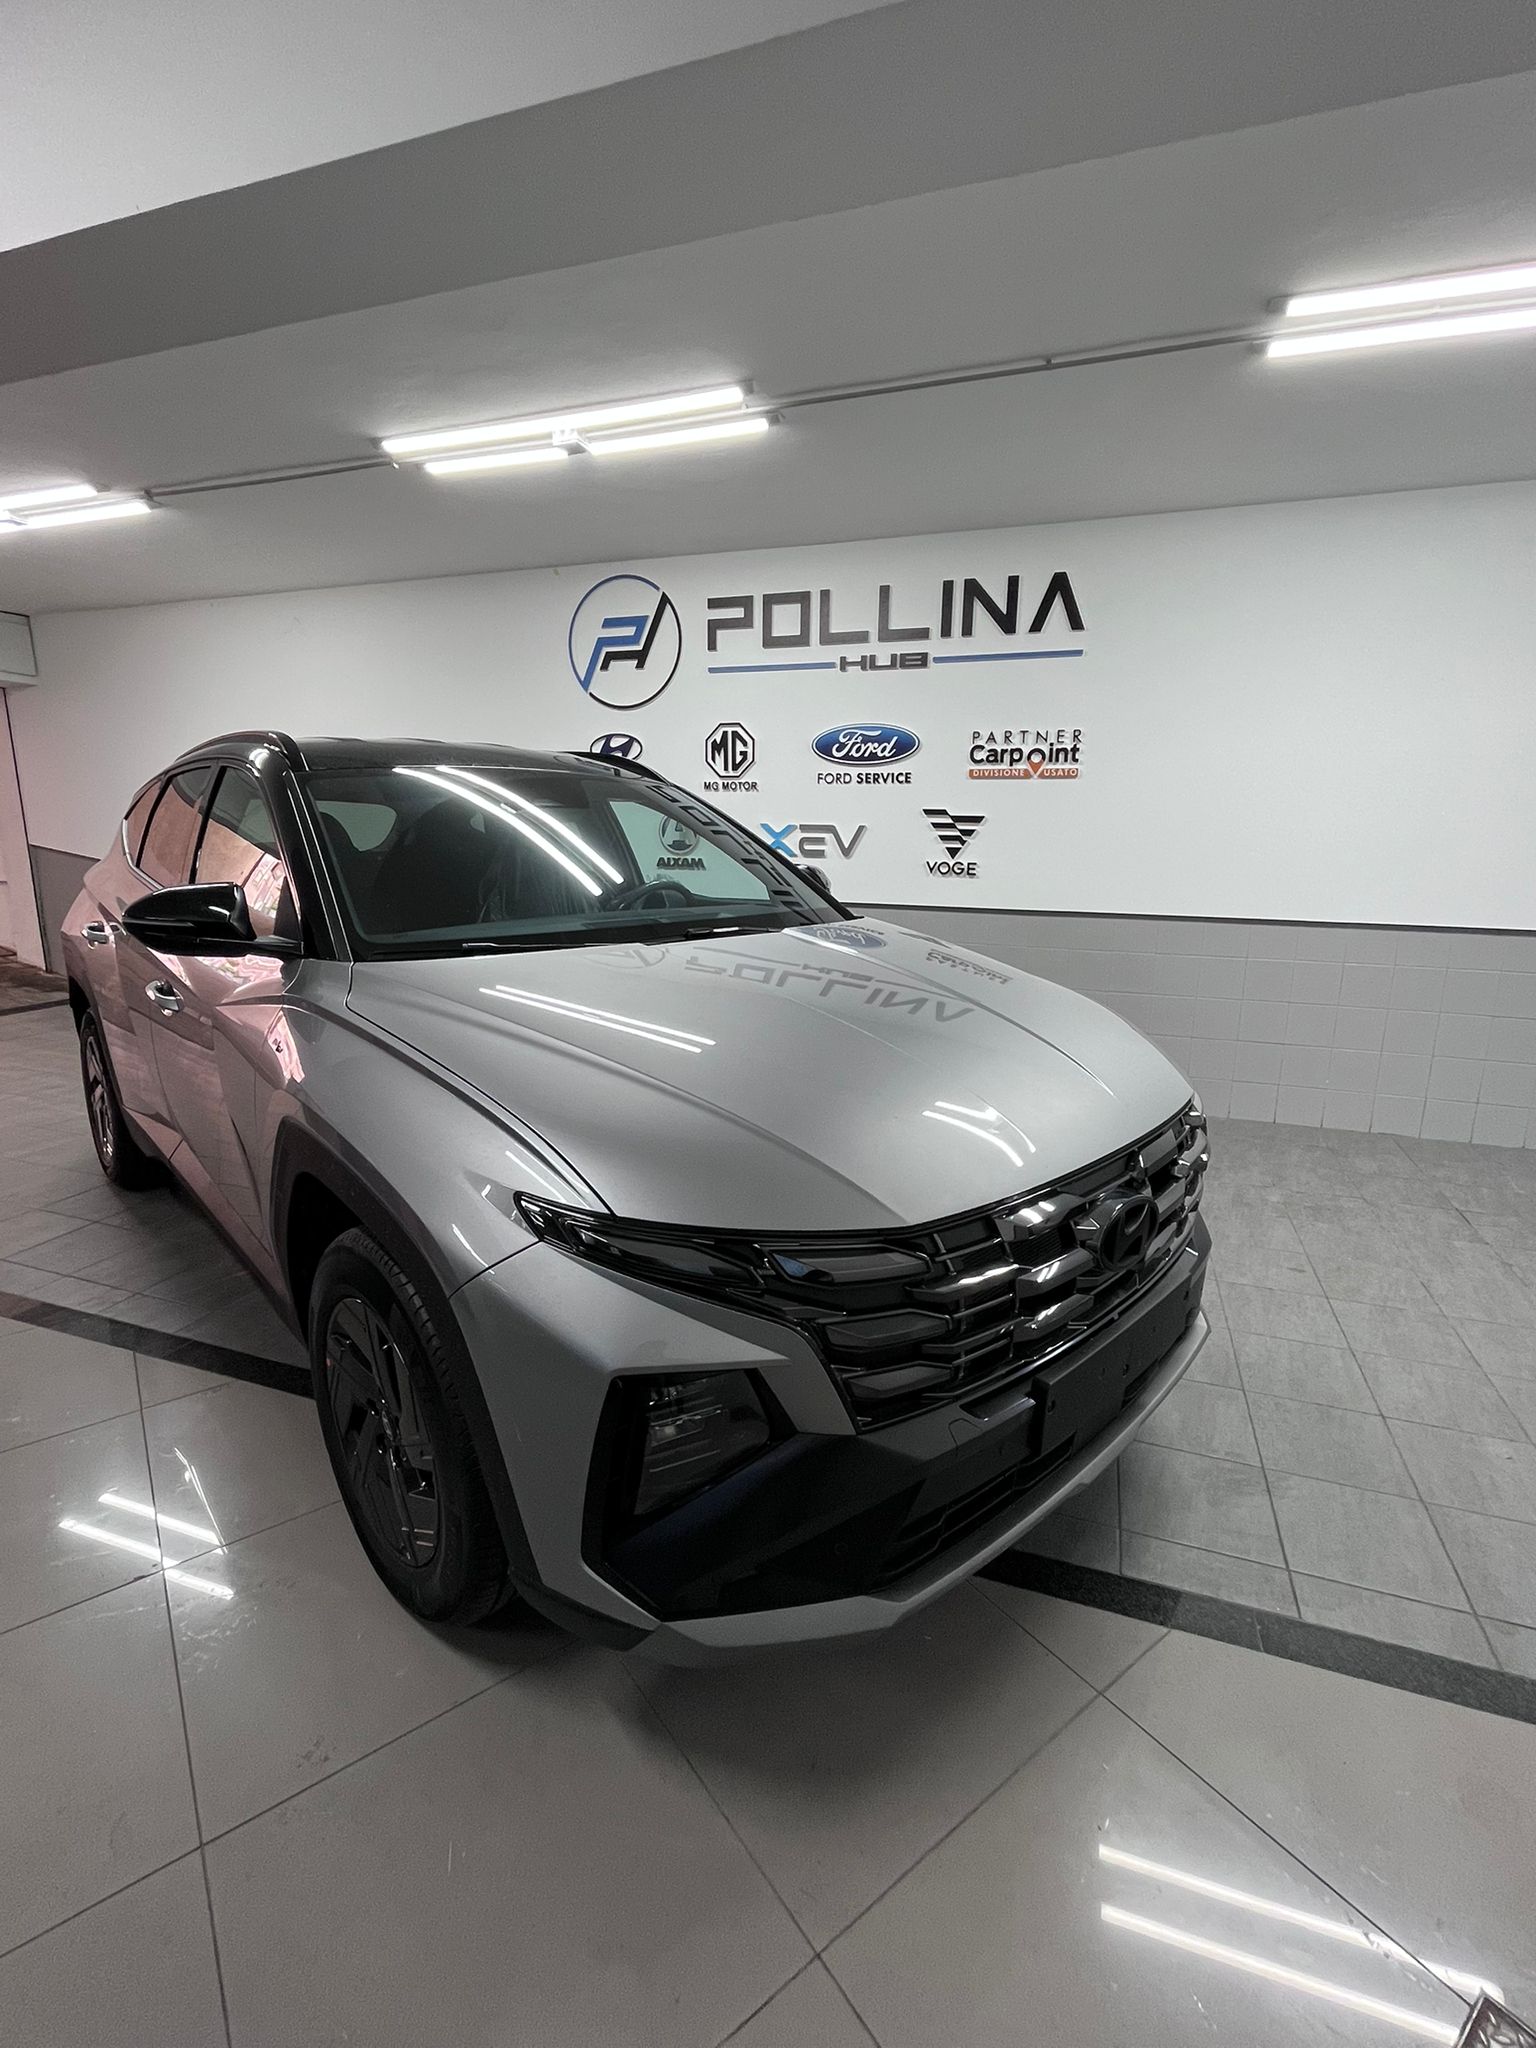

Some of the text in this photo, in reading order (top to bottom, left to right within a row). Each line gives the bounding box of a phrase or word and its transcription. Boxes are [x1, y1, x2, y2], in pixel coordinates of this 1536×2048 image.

[707, 571, 1085, 651] POLLINA
[840, 652, 929, 672] HUB
[832, 729, 898, 758] Ford
[972, 729, 1082, 744] PARTNER
[711, 730, 748, 772] MG
[969, 742, 1080, 767] Carpoint
[817, 772, 912, 784] FORD SERVICE
[973, 768, 1077, 777] DIVISIONE USATO
[704, 782, 757, 791] MG MOTOR
[760, 823, 866, 858] XEV
[926, 861, 977, 876] VOGE
